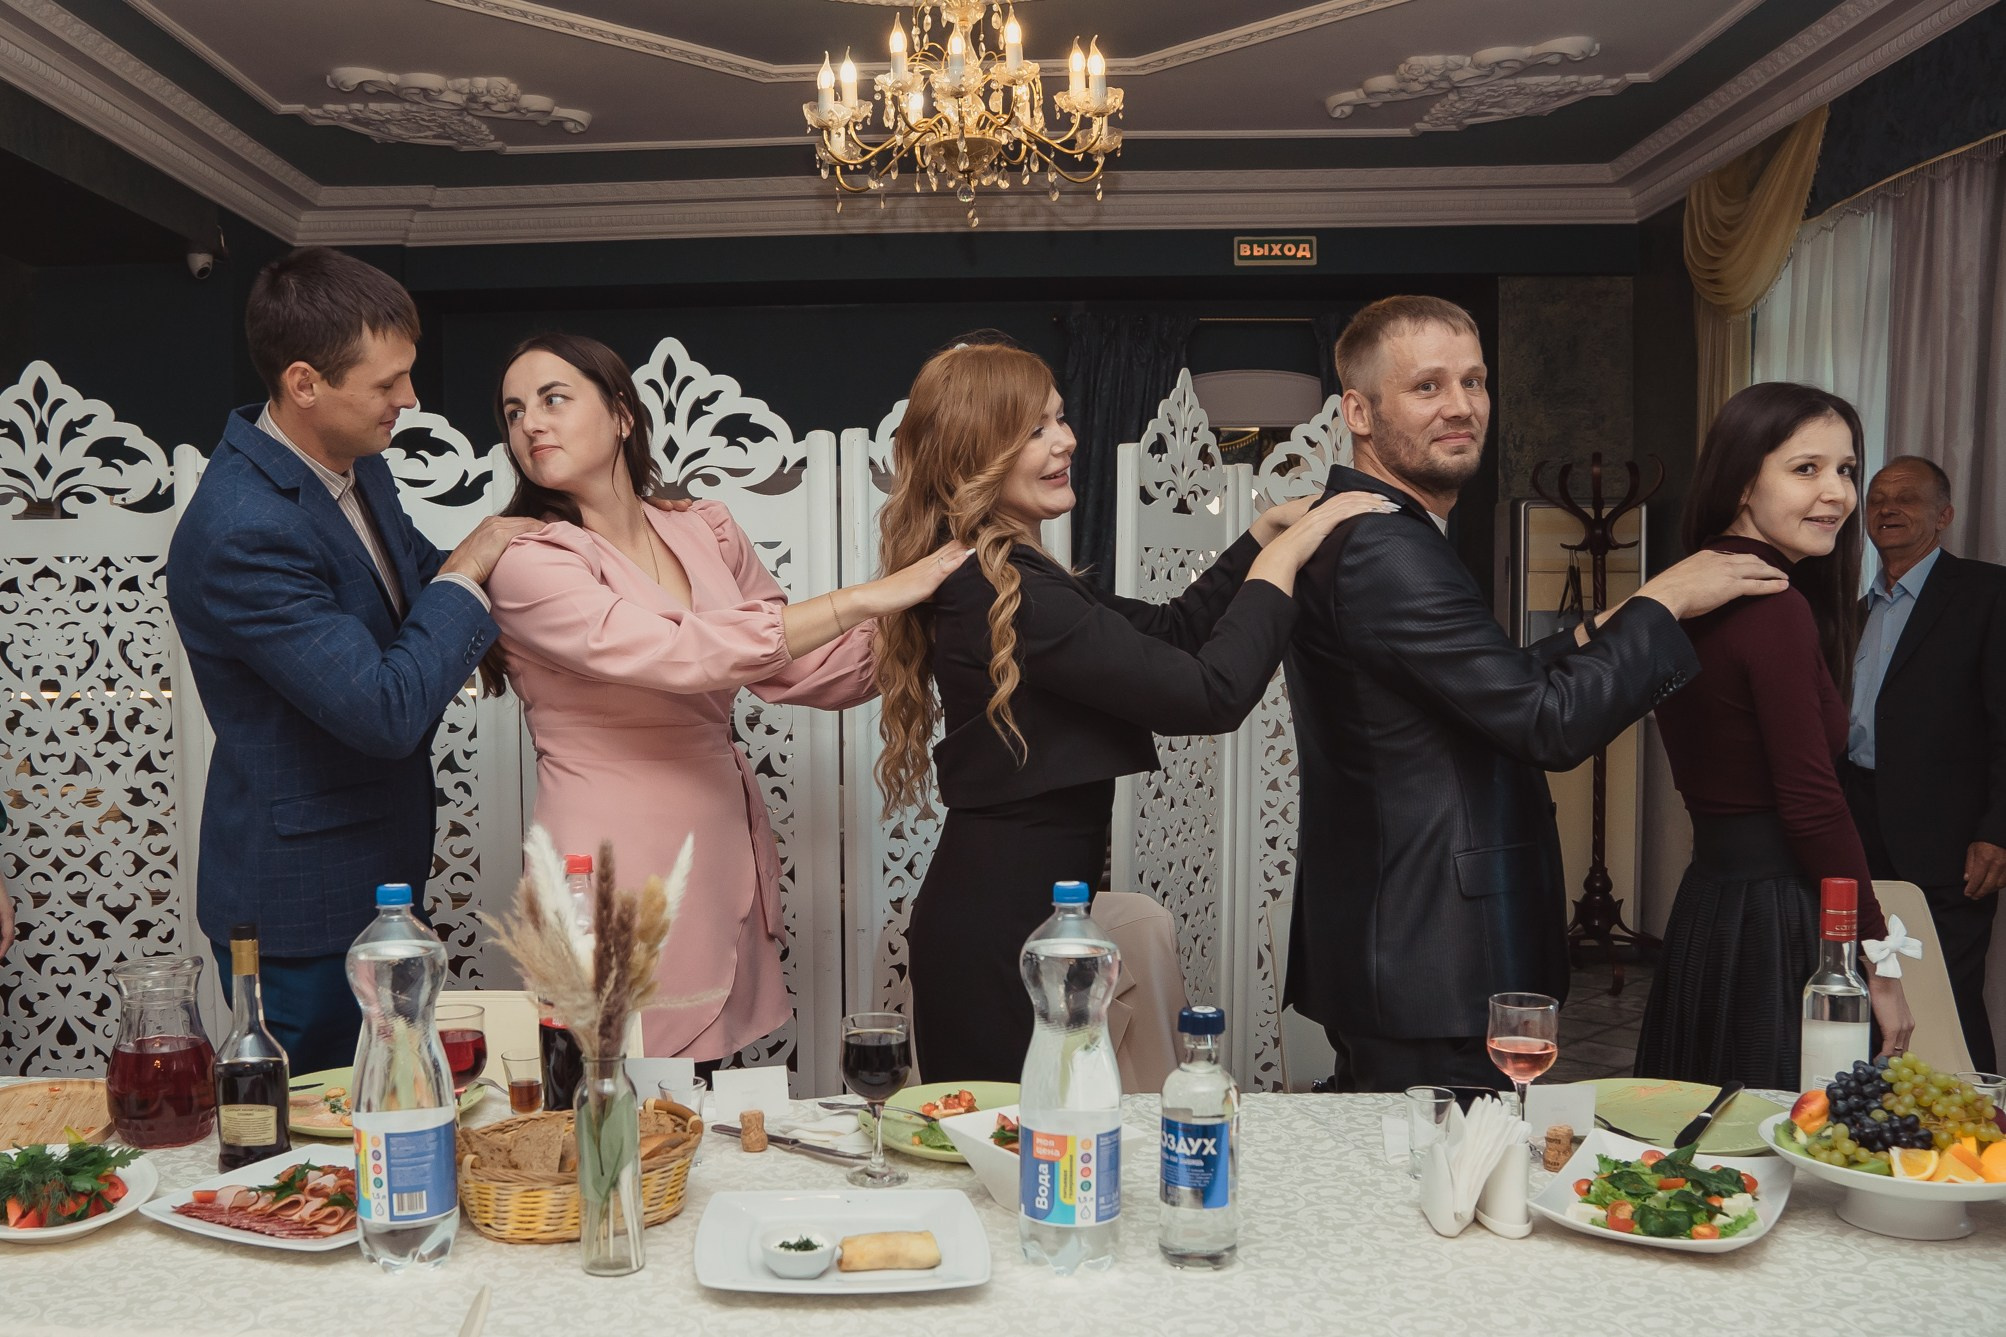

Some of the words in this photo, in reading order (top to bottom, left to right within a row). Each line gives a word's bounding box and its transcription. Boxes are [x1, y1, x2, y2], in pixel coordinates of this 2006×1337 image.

[1239, 243, 1311, 258] ВЫХОД
[1161, 1130, 1218, 1157] ОЗДУХ
[1035, 1163, 1051, 1210] Вода
